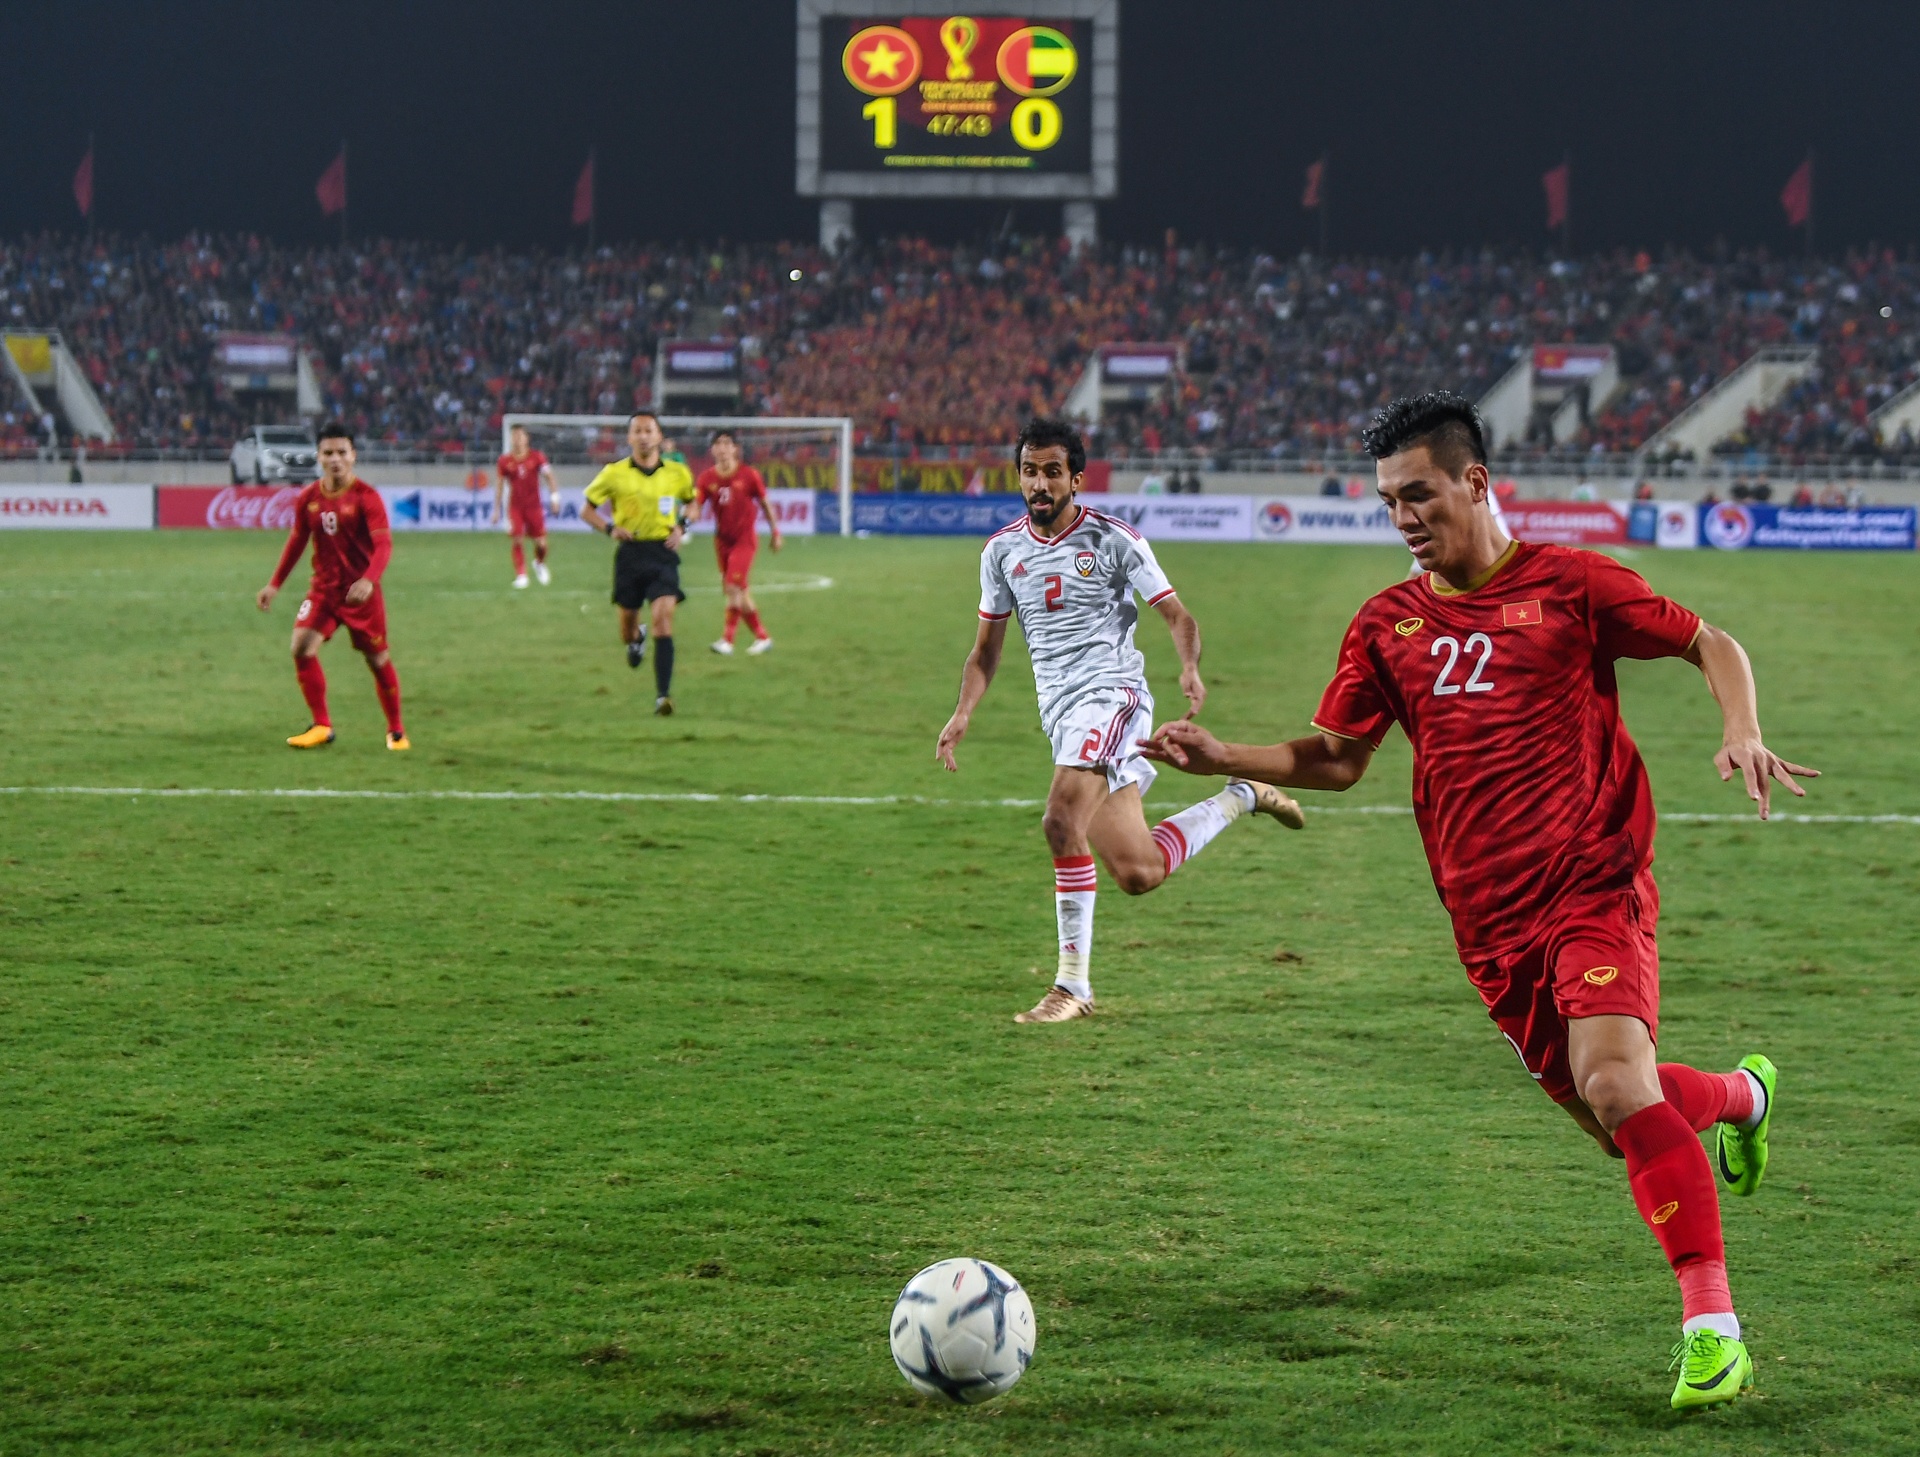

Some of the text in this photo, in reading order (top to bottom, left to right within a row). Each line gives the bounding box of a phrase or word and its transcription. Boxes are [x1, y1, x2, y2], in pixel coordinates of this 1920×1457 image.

[862, 97, 896, 148] 1
[1010, 98, 1062, 150] 0
[321, 511, 338, 536] 19
[429, 502, 491, 520] NEXT
[1527, 512, 1618, 532] CHANNEL
[1044, 574, 1065, 613] 2
[1430, 632, 1495, 696] 22
[1078, 728, 1102, 762] 2
